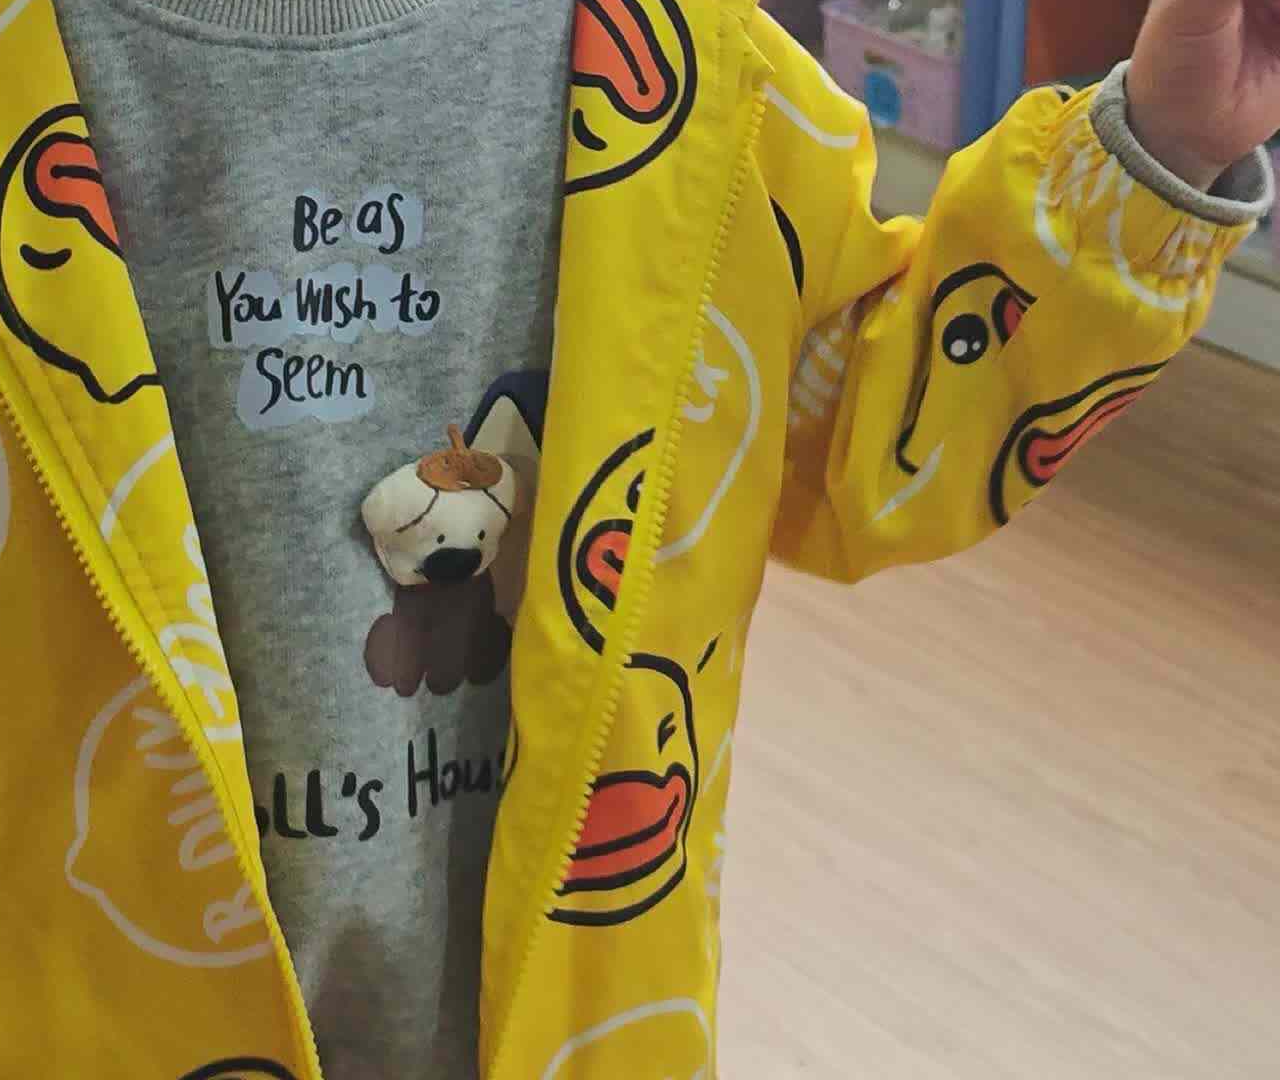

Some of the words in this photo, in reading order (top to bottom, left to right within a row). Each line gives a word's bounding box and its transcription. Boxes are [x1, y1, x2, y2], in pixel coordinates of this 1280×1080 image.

[292, 194, 343, 252] Be
[356, 192, 405, 254] as
[215, 270, 282, 342] You
[390, 272, 441, 324] to
